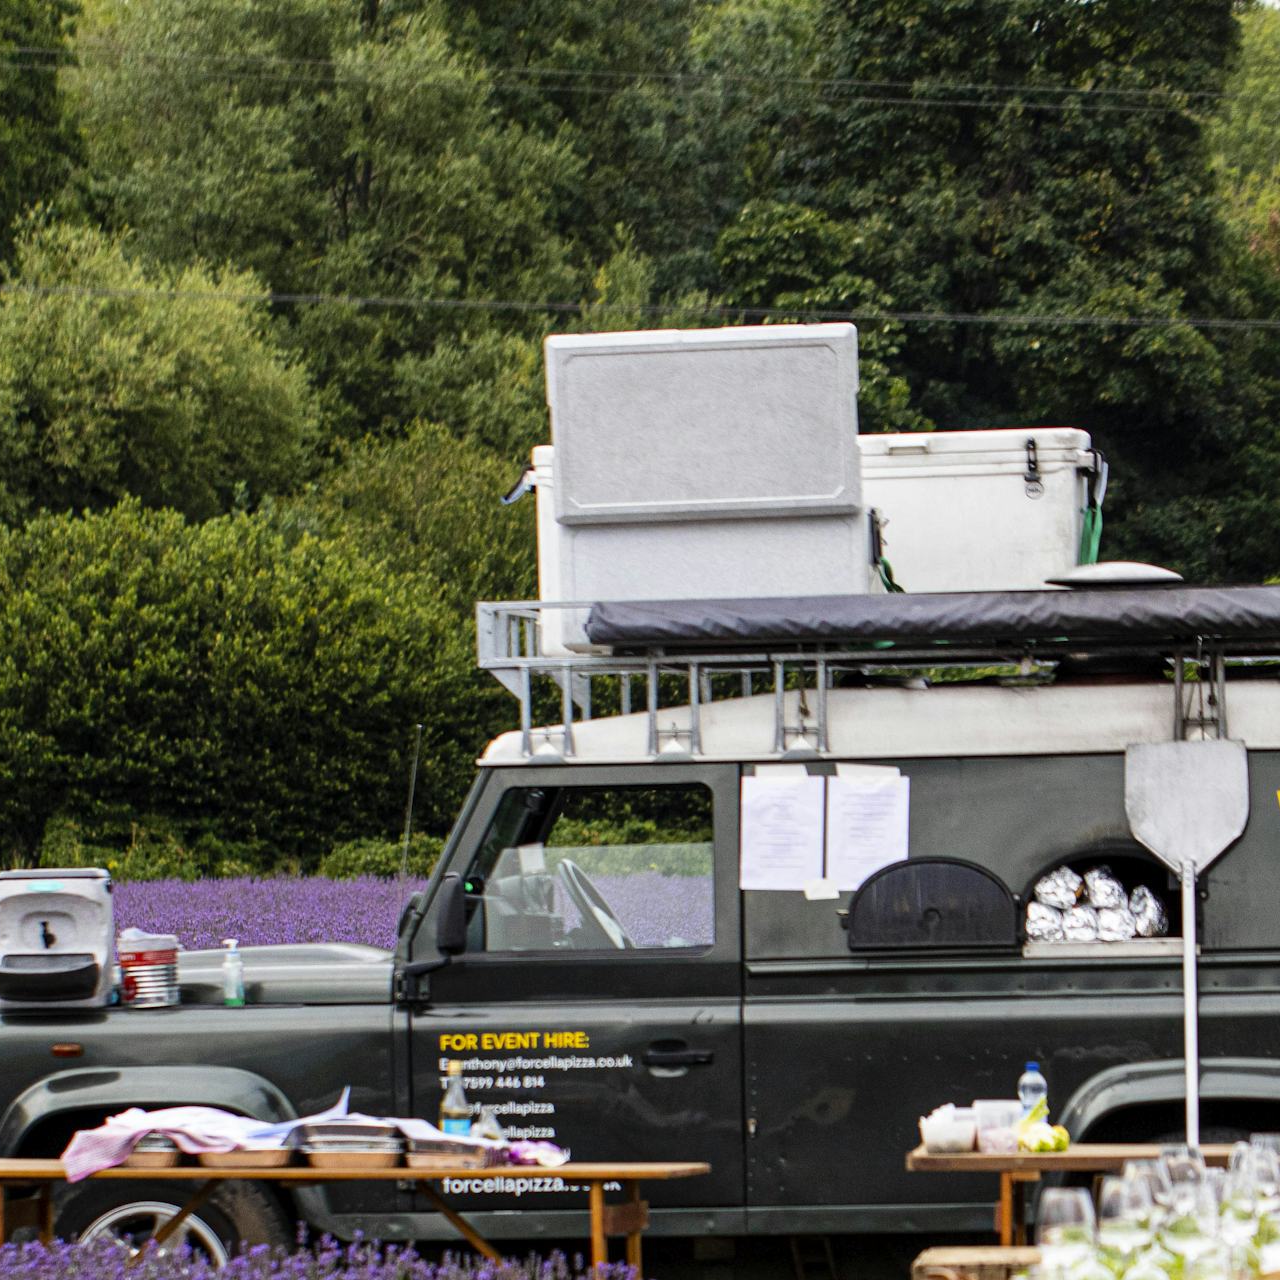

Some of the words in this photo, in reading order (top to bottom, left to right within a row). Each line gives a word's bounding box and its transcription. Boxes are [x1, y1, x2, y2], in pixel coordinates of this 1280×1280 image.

[439, 1034, 478, 1051] FOR
[481, 1033, 540, 1050] EVENT
[543, 1032, 590, 1049] HIRE:
[460, 1054, 633, 1073] nthony@forcellapizza.co.uk
[463, 1076, 493, 1090] 7599
